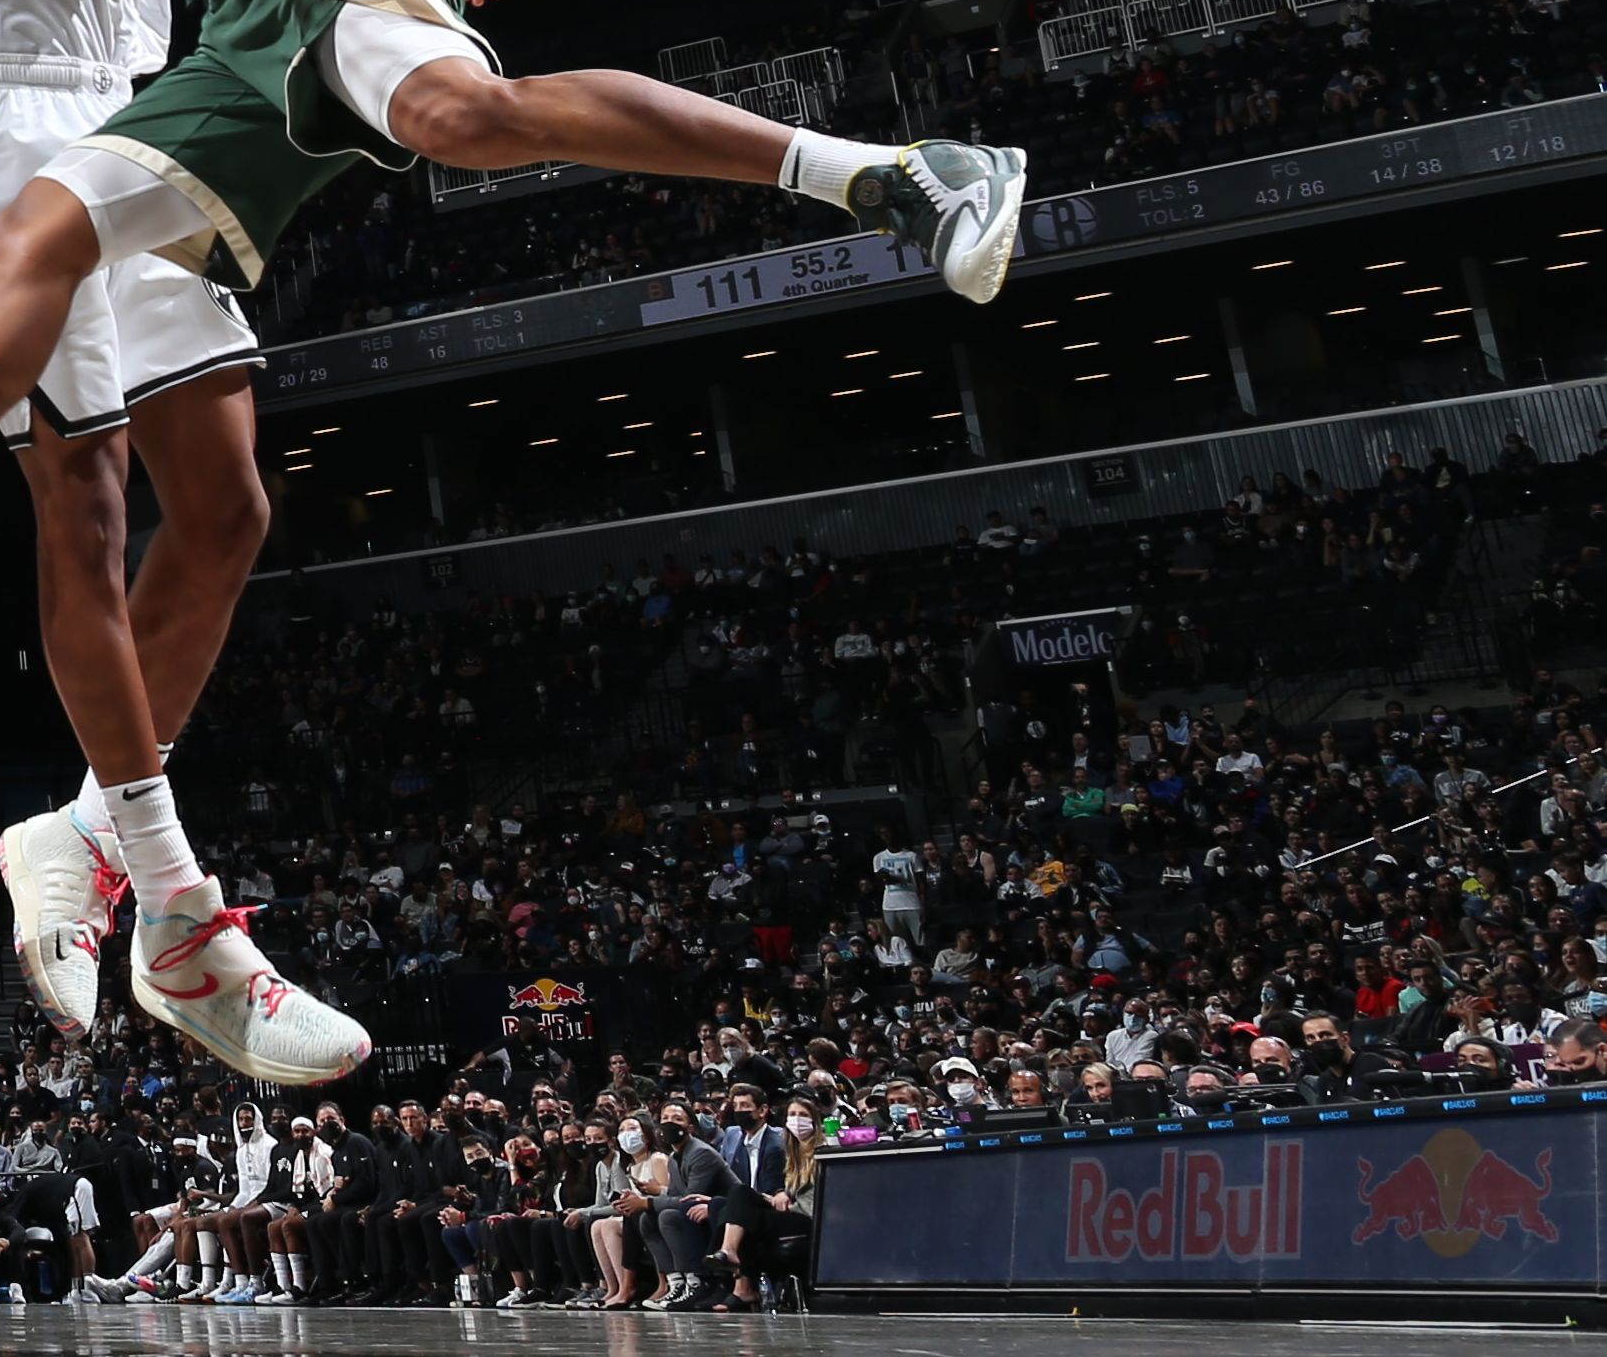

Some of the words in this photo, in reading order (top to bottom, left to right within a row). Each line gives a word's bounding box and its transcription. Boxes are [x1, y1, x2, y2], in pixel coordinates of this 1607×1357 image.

[1507, 117, 1534, 136] FT
[1381, 137, 1421, 159] 3PT
[1490, 145, 1517, 162] 12
[1539, 136, 1566, 153] 18
[1270, 160, 1301, 180] FG
[1370, 167, 1396, 185] 14
[1416, 159, 1443, 177] 38
[1187, 180, 1200, 195] 5
[1255, 188, 1280, 205] 43
[1299, 180, 1325, 197] 86
[1192, 204, 1205, 220] 2
[791, 246, 853, 278] 55.2
[697, 266, 762, 308] 111
[782, 282, 807, 298] 4th
[810, 272, 870, 294] Quarter
[514, 309, 523, 324] 3
[417, 325, 448, 343] AST
[517, 332, 525, 345] 1
[360, 336, 393, 354] REB
[428, 346, 446, 361] 16
[289, 351, 308, 367] FT
[370, 356, 388, 370] 48
[278, 372, 296, 388] 20
[309, 367, 327, 383] 29
[1095, 468, 1125, 482] 104
[430, 563, 454, 578] 102
[1066, 1146, 1179, 1263] Red
[1181, 1137, 1304, 1263] Bull
